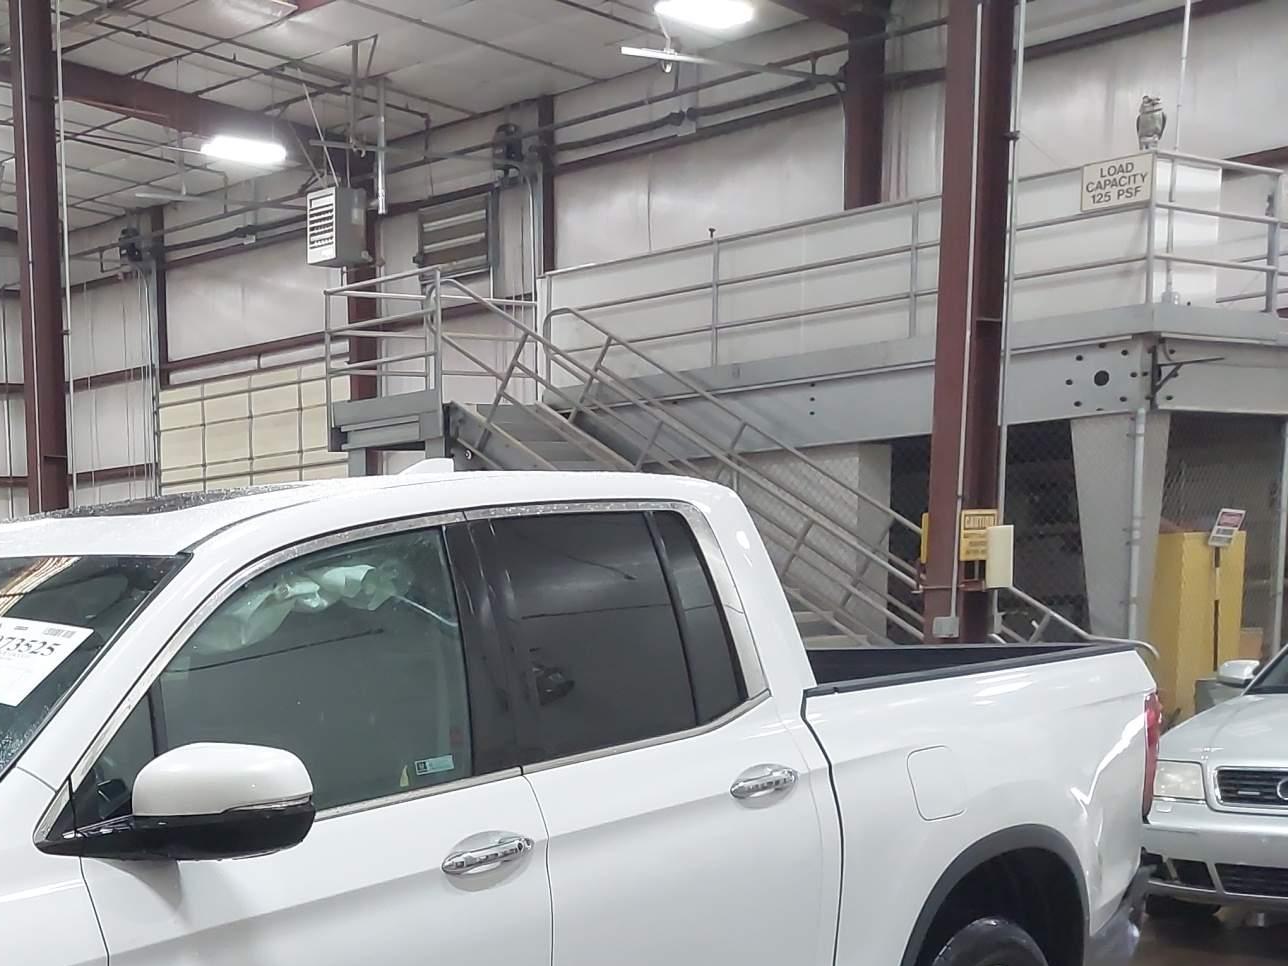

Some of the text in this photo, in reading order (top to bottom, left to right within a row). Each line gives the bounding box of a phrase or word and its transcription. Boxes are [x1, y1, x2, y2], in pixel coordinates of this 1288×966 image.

[1099, 162, 1135, 178] LOAD
[1085, 172, 1148, 193] CAPACITY
[1091, 185, 1142, 204] 125 PSF
